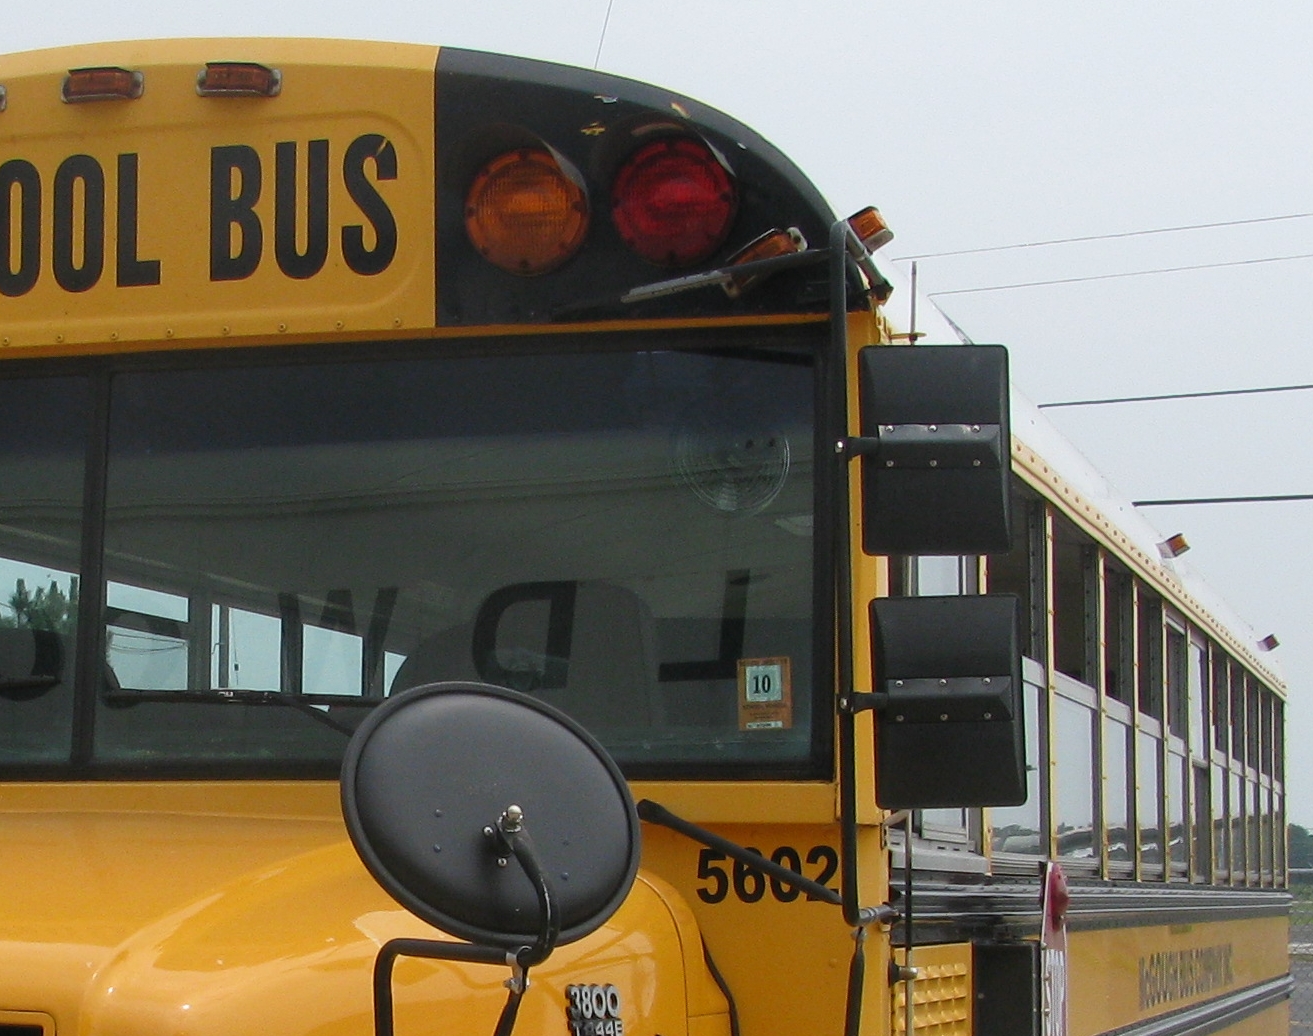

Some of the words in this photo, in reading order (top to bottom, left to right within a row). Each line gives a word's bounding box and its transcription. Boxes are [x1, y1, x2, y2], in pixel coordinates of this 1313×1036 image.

[208, 132, 399, 282] BUS
[753, 674, 771, 694] 10
[696, 845, 840, 904] 5602
[568, 985, 620, 1019] 3800
